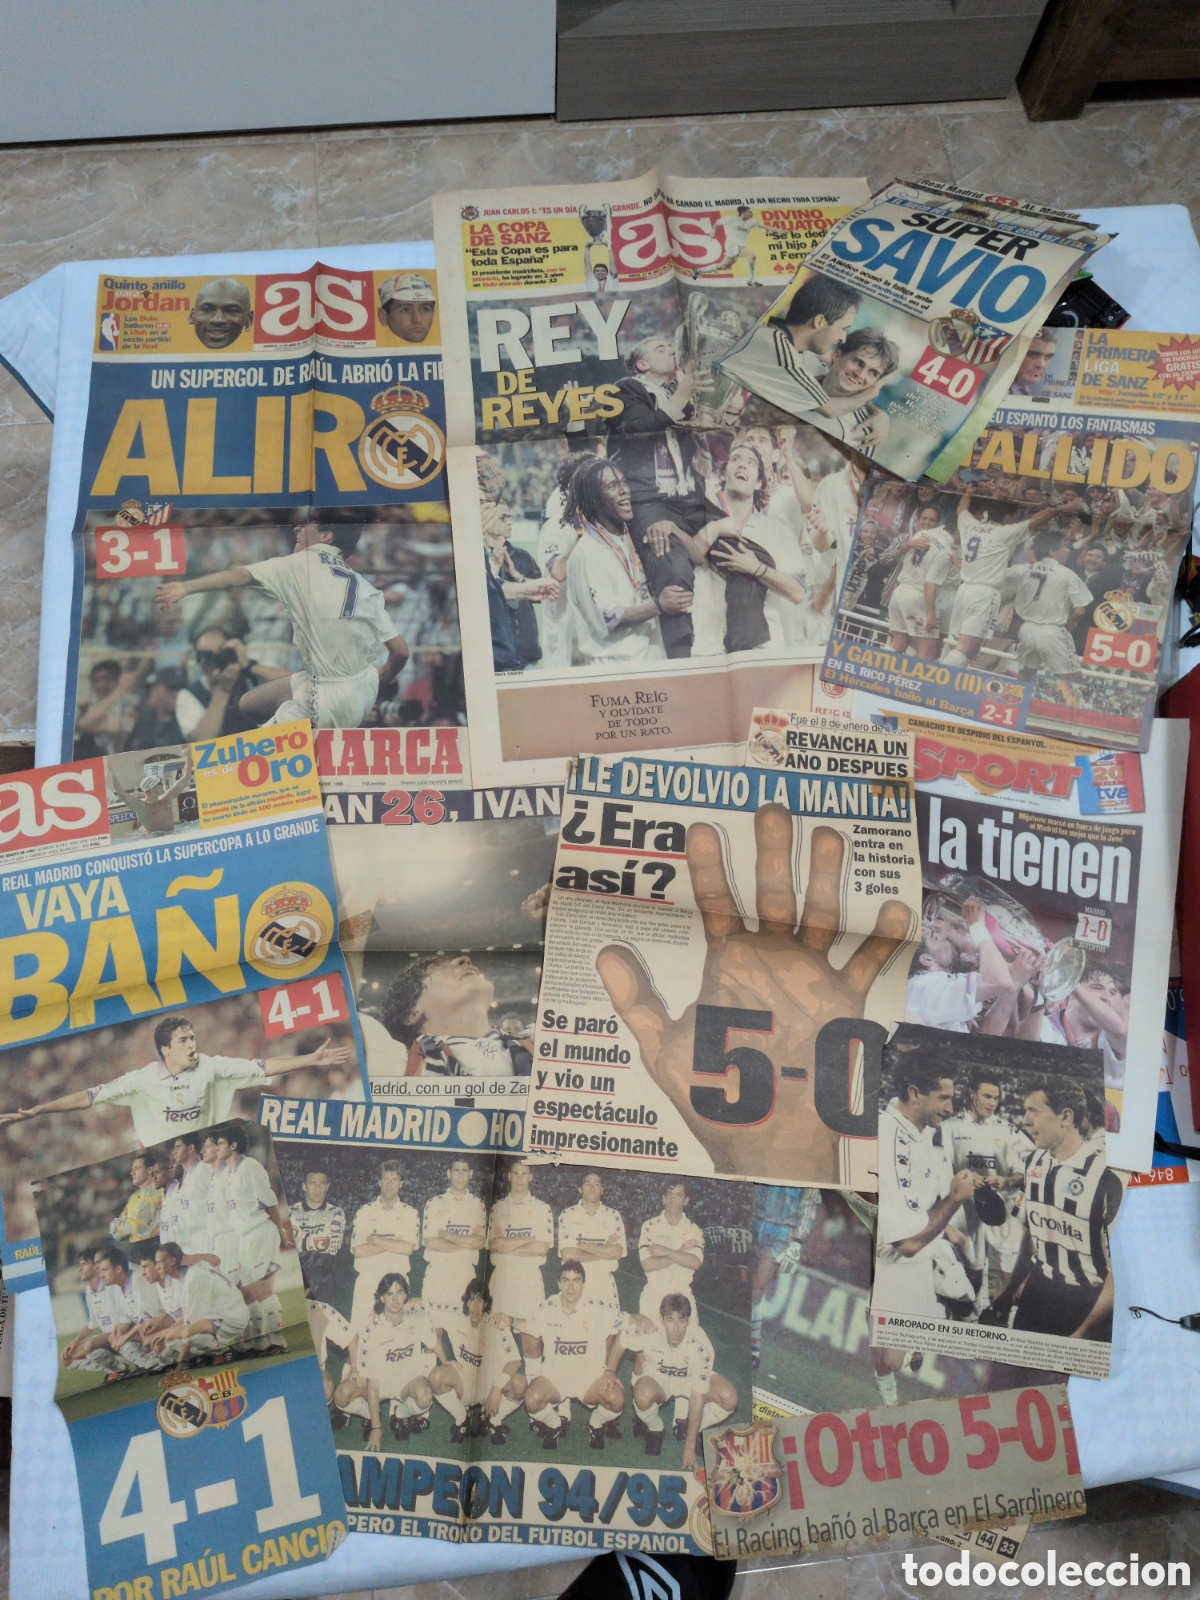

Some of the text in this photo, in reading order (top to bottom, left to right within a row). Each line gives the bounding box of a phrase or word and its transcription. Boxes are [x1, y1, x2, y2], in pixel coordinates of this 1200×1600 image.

[503, 207, 530, 215] CARLOS
[676, 199, 713, 208] GANADO EL
[920, 179, 1081, 219] Real Madrid Madrid
[470, 221, 548, 235] LA COPA
[761, 209, 823, 221] DIVINO
[470, 232, 552, 247] DE SANZ
[618, 213, 723, 269] as
[768, 242, 783, 251] mi
[791, 231, 801, 239] lo
[902, 213, 1039, 261] SUPER
[471, 258, 497, 266] toda
[831, 218, 1047, 324] SAVIO
[104, 278, 148, 290] Quinto
[826, 263, 930, 310] Madrid el
[831, 258, 933, 303] Atlético acusó fatiga ante
[102, 291, 190, 312] Jordan
[261, 274, 368, 336] as
[477, 300, 631, 372] REY
[1088, 333, 1108, 345] LA
[151, 359, 419, 389] UN SUPERGOL DE RAÚL ABRIÓ LA
[918, 356, 975, 399] 4-0
[1084, 360, 1119, 373] LIGA
[497, 369, 537, 396] DE
[1055, 391, 1073, 399] SANZ
[1081, 373, 1149, 390] DE SANZ
[481, 384, 625, 431] REYES
[1061, 413, 1155, 435] LOS FANTASMAS
[100, 530, 178, 573] 3-1
[1089, 634, 1151, 668] 5-0
[827, 658, 857, 674] EN EL
[847, 646, 983, 695] GATILLAZO (II)
[839, 672, 923, 704] Hércules bailó
[599, 705, 664, 718] Y OLVÍDATE
[608, 719, 620, 728] DE
[790, 713, 827, 726] Fue el 8
[982, 704, 1014, 725] 2-1
[596, 729, 637, 740] POR UN
[786, 731, 878, 754] REVANCHA
[883, 740, 908, 756] UN
[908, 718, 945, 732] CAMACHO
[947, 724, 956, 733] SE
[957, 727, 991, 740] DESPIDIO
[992, 734, 1005, 742] DEL
[1007, 736, 1047, 749] ESPANYOL.
[195, 731, 308, 770] Zubero
[785, 750, 908, 778] AÑO DESPUES
[237, 754, 313, 788] Oro
[914, 738, 1082, 799] SPORT
[1092, 766, 1123, 781] 20
[620, 761, 750, 808] DEVOLVIO
[0, 768, 102, 846] as
[209, 796, 251, 808] plusmarquista
[295, 795, 318, 803] espalda
[381, 787, 561, 825] 26, IVAN
[562, 799, 686, 853] ¿Era
[853, 825, 911, 837] Zamorano
[1019, 812, 1136, 836] Mijatovic marcó fuera pero
[1069, 830, 1123, 843] mejor que Juve
[2, 818, 320, 892] REAL MADRID CONQUISTÓ LA SUPERCOPA A LO GRANDE
[889, 841, 903, 850] en
[928, 796, 1132, 904] la tienen
[555, 859, 677, 901] así?
[865, 882, 899, 895] goles
[880, 870, 901, 879] sus
[15, 876, 131, 931] VAYA
[1079, 914, 1108, 942] 1-0
[267, 980, 341, 1031] 4-1
[542, 1008, 619, 1037] Se paró
[538, 1041, 631, 1065] el mundo
[534, 1068, 615, 1093] y vio un
[689, 1004, 890, 1140] 5-0
[445, 1081, 506, 1097] un gol de
[260, 1098, 451, 1143] REAL MADRID
[533, 1099, 658, 1126] espectáculo
[530, 1124, 679, 1158] impresionante
[888, 1318, 1009, 1342] ARROPADO EN SU RETORNO.
[783, 1409, 950, 1510] ¡Otro
[99, 1395, 322, 1566] 4-1
[537, 1467, 688, 1529] 94/95
[400, 1519, 598, 1548] EL DEL FUTBOL
[713, 1488, 1084, 1559] El Racing bañó al Barça en El Sardinero
[979, 1533, 1016, 1555] 44 33
[93, 1520, 346, 1600] POR RAÚL CANCIO
